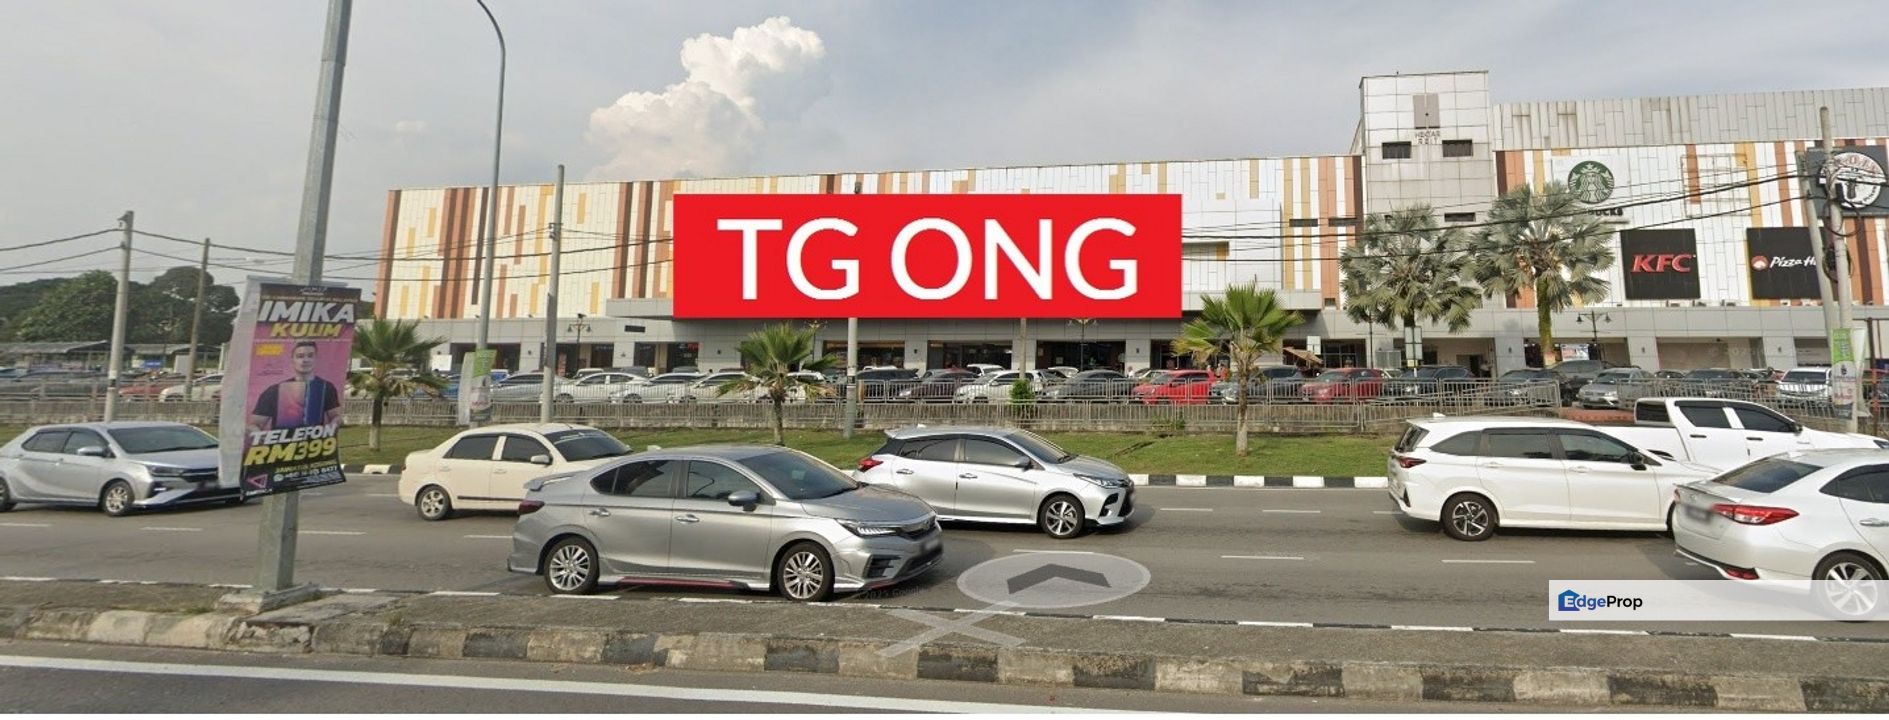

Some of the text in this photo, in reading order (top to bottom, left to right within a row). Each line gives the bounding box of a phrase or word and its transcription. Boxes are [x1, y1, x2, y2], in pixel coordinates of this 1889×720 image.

[1631, 254, 1692, 273] KFC
[1769, 256, 1803, 268] Pizza
[258, 301, 354, 323] IMIKA
[270, 322, 344, 337] KULIM
[250, 423, 338, 446] TELEFON
[244, 437, 337, 466] RM399
